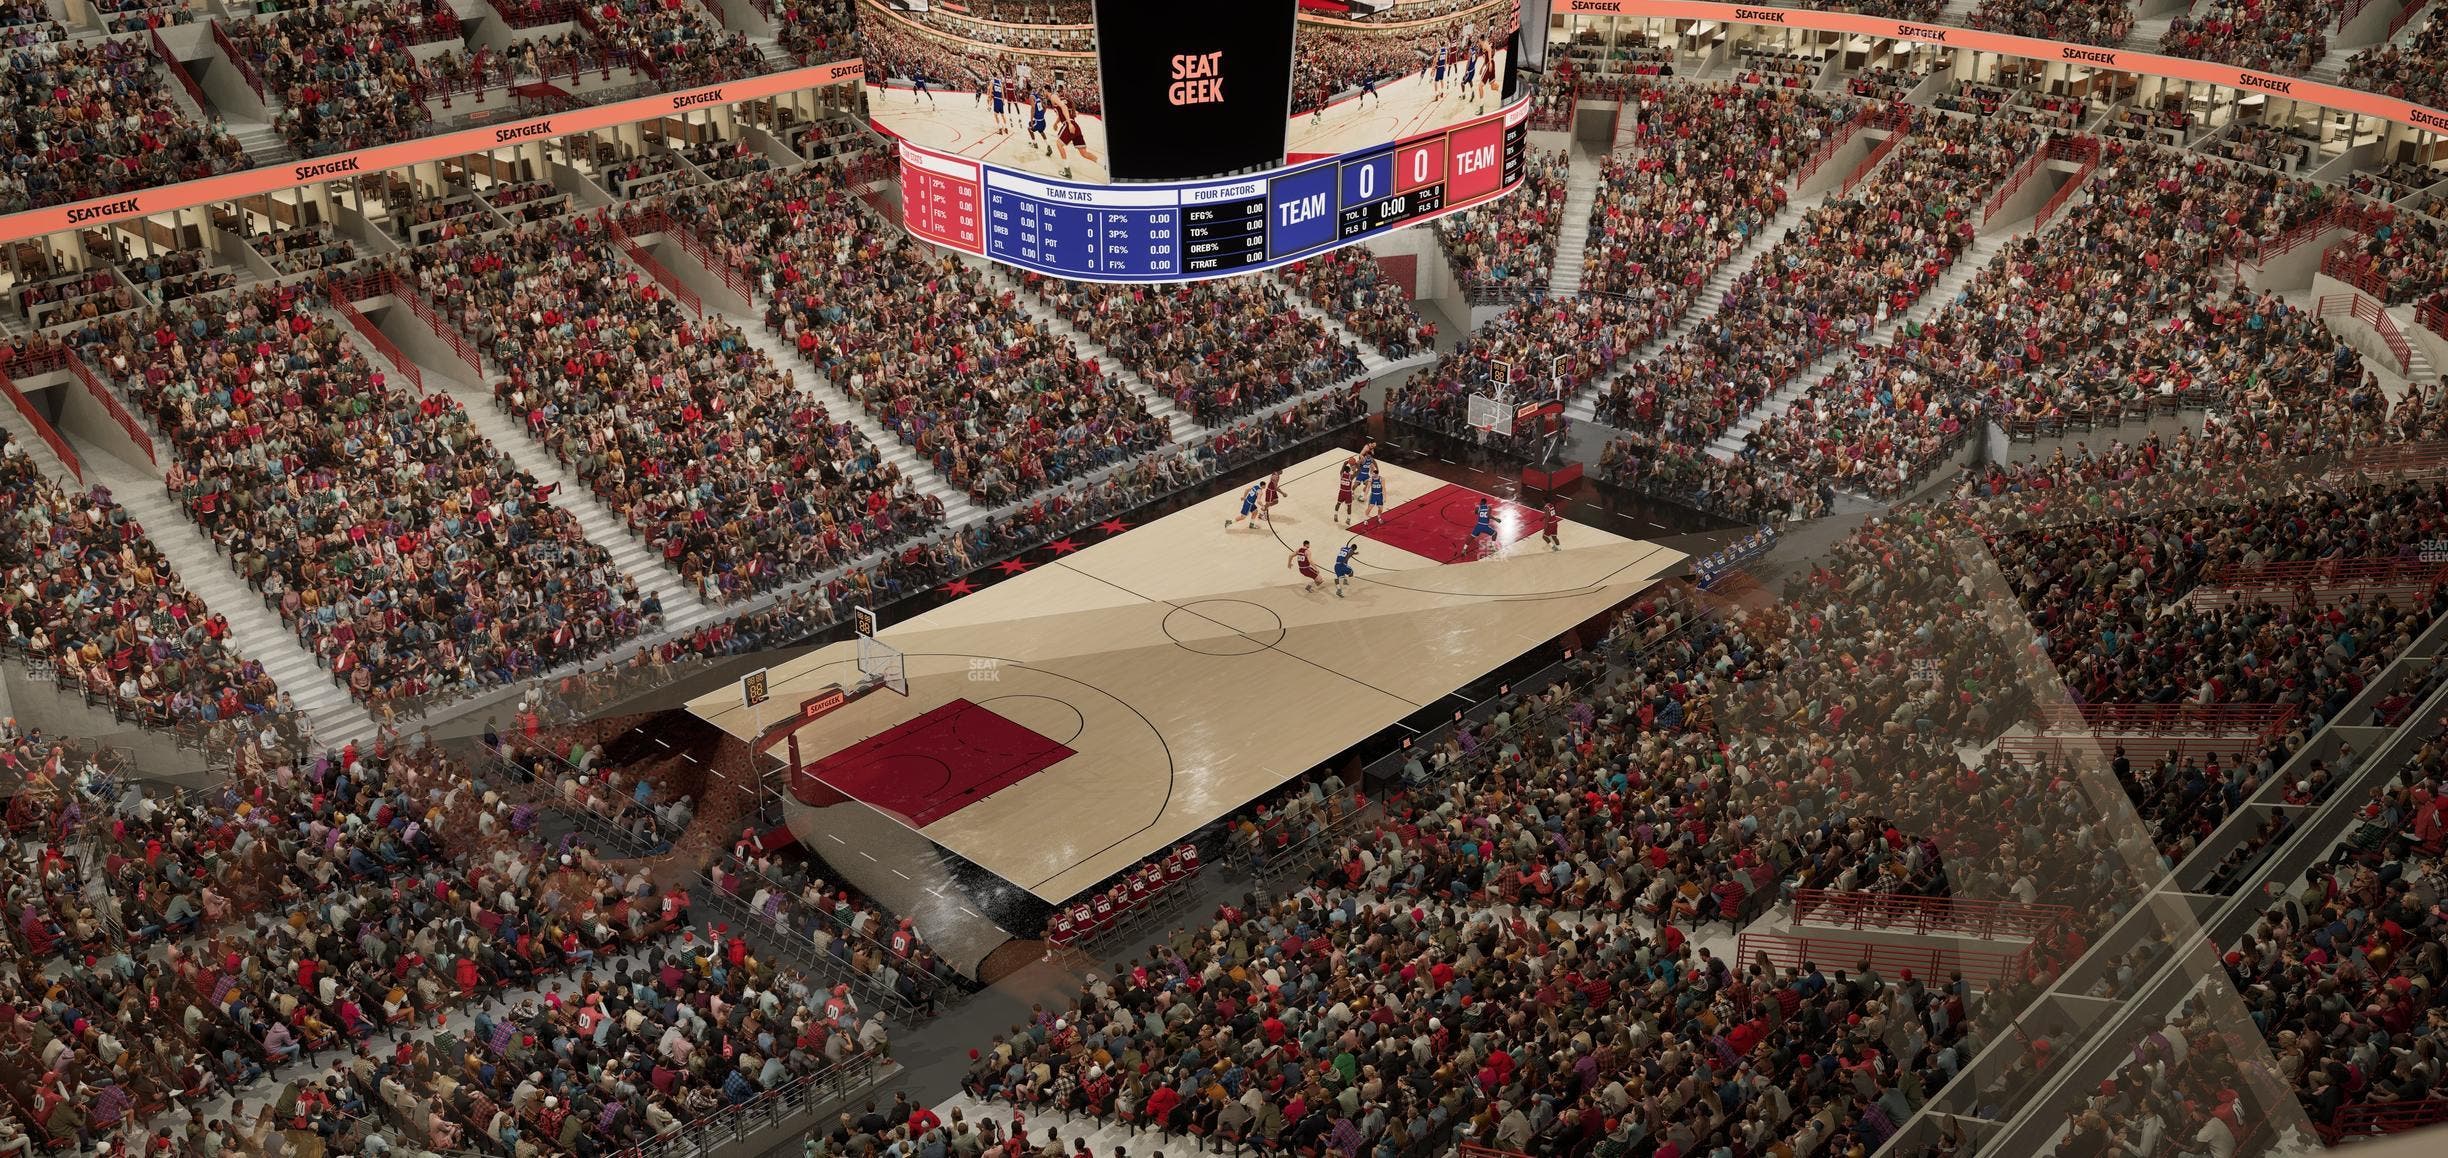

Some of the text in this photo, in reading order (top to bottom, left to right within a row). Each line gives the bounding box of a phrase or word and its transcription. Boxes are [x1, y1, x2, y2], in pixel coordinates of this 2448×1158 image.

[1571, 0, 1621, 12] SEATGEEK
[1735, 9, 1785, 23] SEATGEEK
[1897, 25, 1947, 41] SEATGEEK
[2062, 47, 2116, 65] SEATGEEK
[831, 64, 864, 79] SEATGE
[1171, 50, 1223, 80] SEAT
[2239, 73, 2292, 94] SEATGEEK
[672, 88, 724, 109] SEATGEEK
[1168, 77, 1225, 106] GEEK
[2410, 109, 2448, 130] SEATGEE
[495, 120, 553, 143] SEATGEEK
[1414, 148, 1428, 183] 0
[1456, 143, 1495, 176] TEAM
[295, 156, 360, 181] SEATGEEK
[1359, 163, 1375, 199] 0
[1045, 187, 1093, 202] TEAM STATS
[1194, 184, 1256, 201] FOUR FACTORS
[1419, 189, 1432, 199] TOL
[67, 197, 141, 224] SEATGEEK
[992, 195, 1034, 213] AST 0.00
[1279, 192, 1326, 227] TEAM
[1380, 196, 1406, 218] 0:00
[1418, 202, 1431, 213] FLS
[1044, 207, 1093, 223] BLK 0
[1108, 214, 1170, 224] 2P% 0.00
[1190, 203, 1263, 221] EFG% 0.00
[1345, 212, 1359, 221] TOL
[1020, 216, 1035, 228] 0.00
[1246, 219, 1263, 231] 0.00
[1345, 224, 1359, 235] FLS
[1021, 232, 1036, 244] 0.00
[1087, 228, 1094, 238] 0
[1108, 229, 1170, 239] 3P% 0.00
[994, 240, 1036, 259] STL 0.00
[1087, 243, 1094, 253] 0
[1109, 245, 1170, 255] FG% 0.00
[1190, 235, 1263, 254] OREB% 0.00
[1045, 253, 1095, 269] STL 0
[1150, 260, 1171, 270] 0.00
[1190, 251, 1263, 270] FTRATE 0.00
[859, 620, 870, 635] 88
[750, 682, 763, 698] 88
[810, 695, 841, 714] SEATGEEK
[736, 845, 745, 858] 0
[1182, 849, 1196, 861] 00
[1148, 871, 1161, 883] 00
[1132, 881, 1144, 892] 00
[662, 898, 672, 911] 00
[1097, 902, 1110, 913] 00
[1075, 909, 1090, 921] 00
[1058, 920, 1070, 932] 00
[894, 936, 906, 951] 00
[827, 1004, 839, 1020] 00
[579, 1013, 590, 1029] 00
